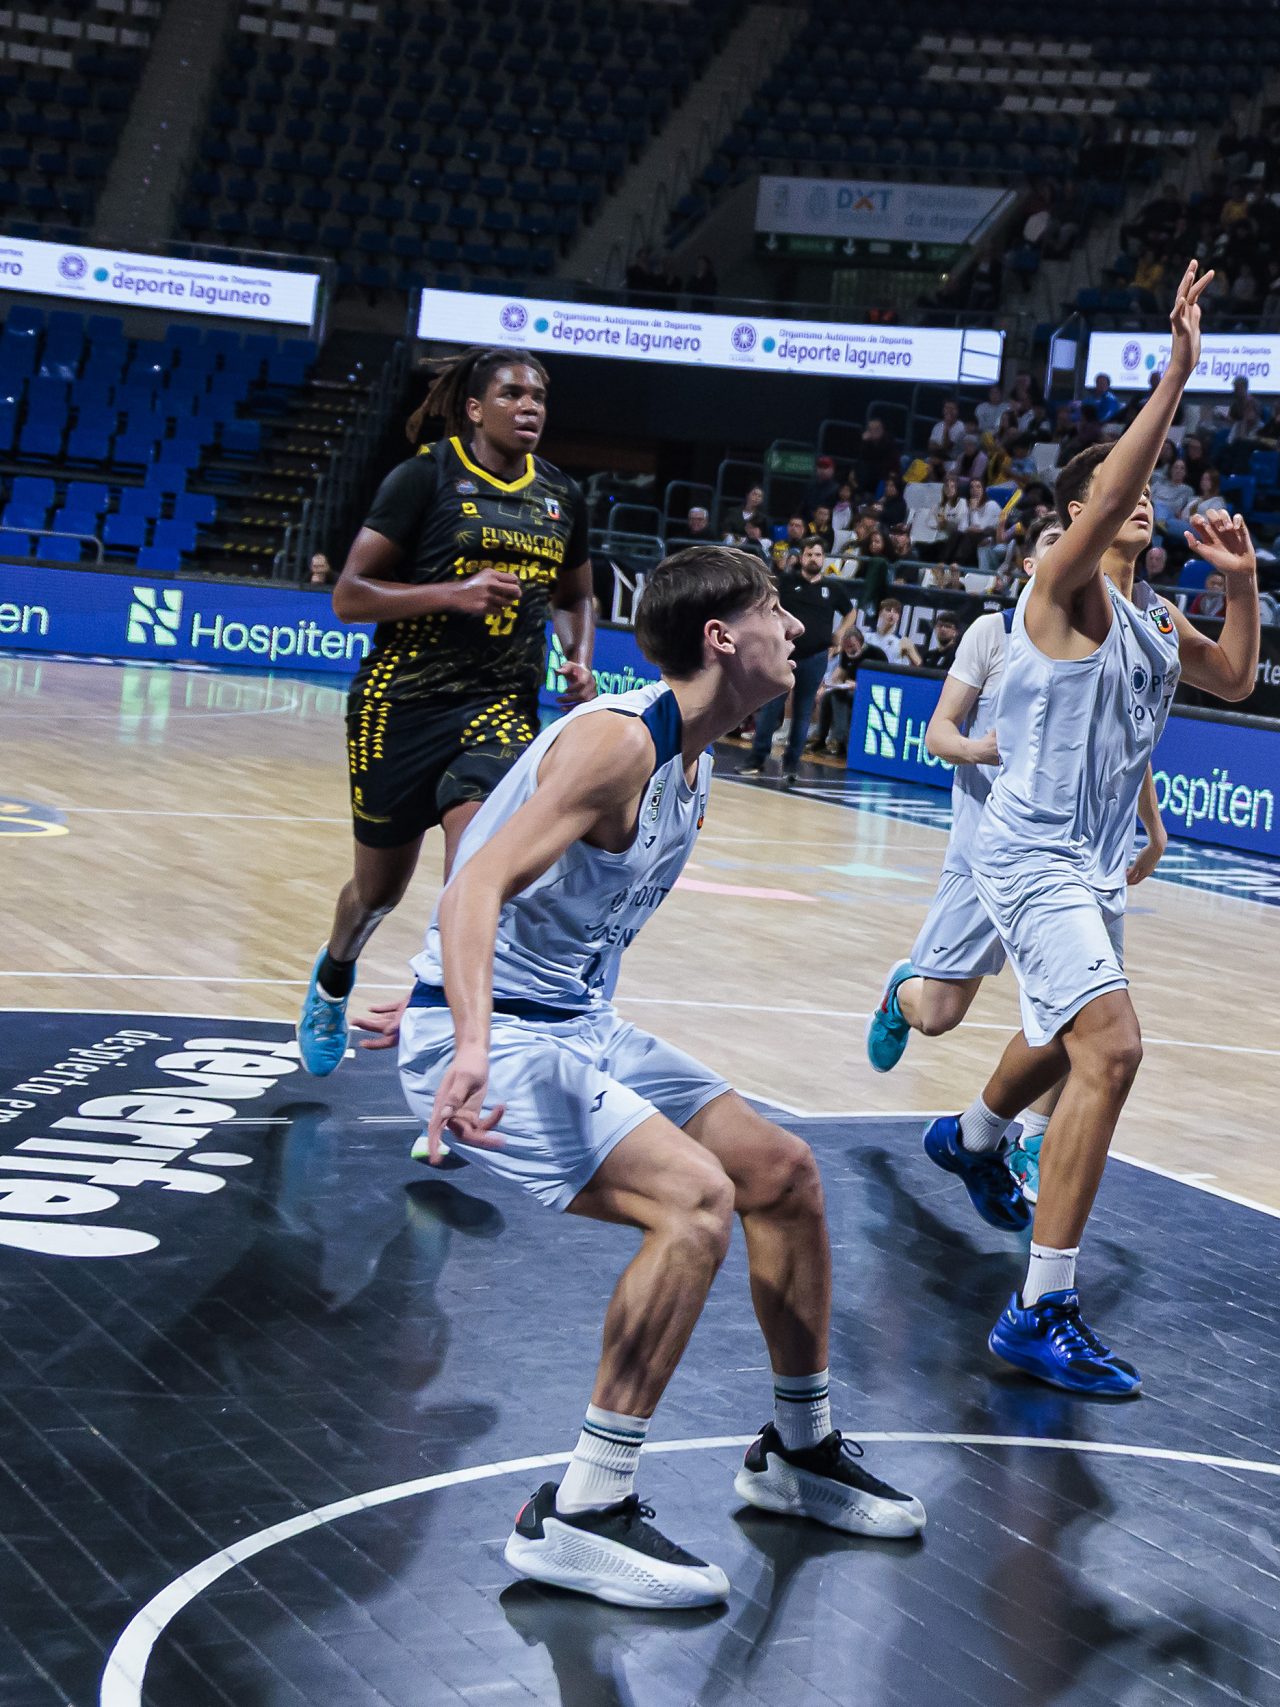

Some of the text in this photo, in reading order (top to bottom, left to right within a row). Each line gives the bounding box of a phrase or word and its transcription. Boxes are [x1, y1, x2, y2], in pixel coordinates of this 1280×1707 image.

[112, 272, 272, 307] deporte lagunero
[552, 321, 701, 352] deporte lagunero
[778, 341, 912, 368] deporte lagunero
[1212, 356, 1270, 381] lagunero
[191, 612, 371, 662] Hospiten
[1152, 767, 1274, 832] ospiten
[12, 1029, 173, 1095] despierta
